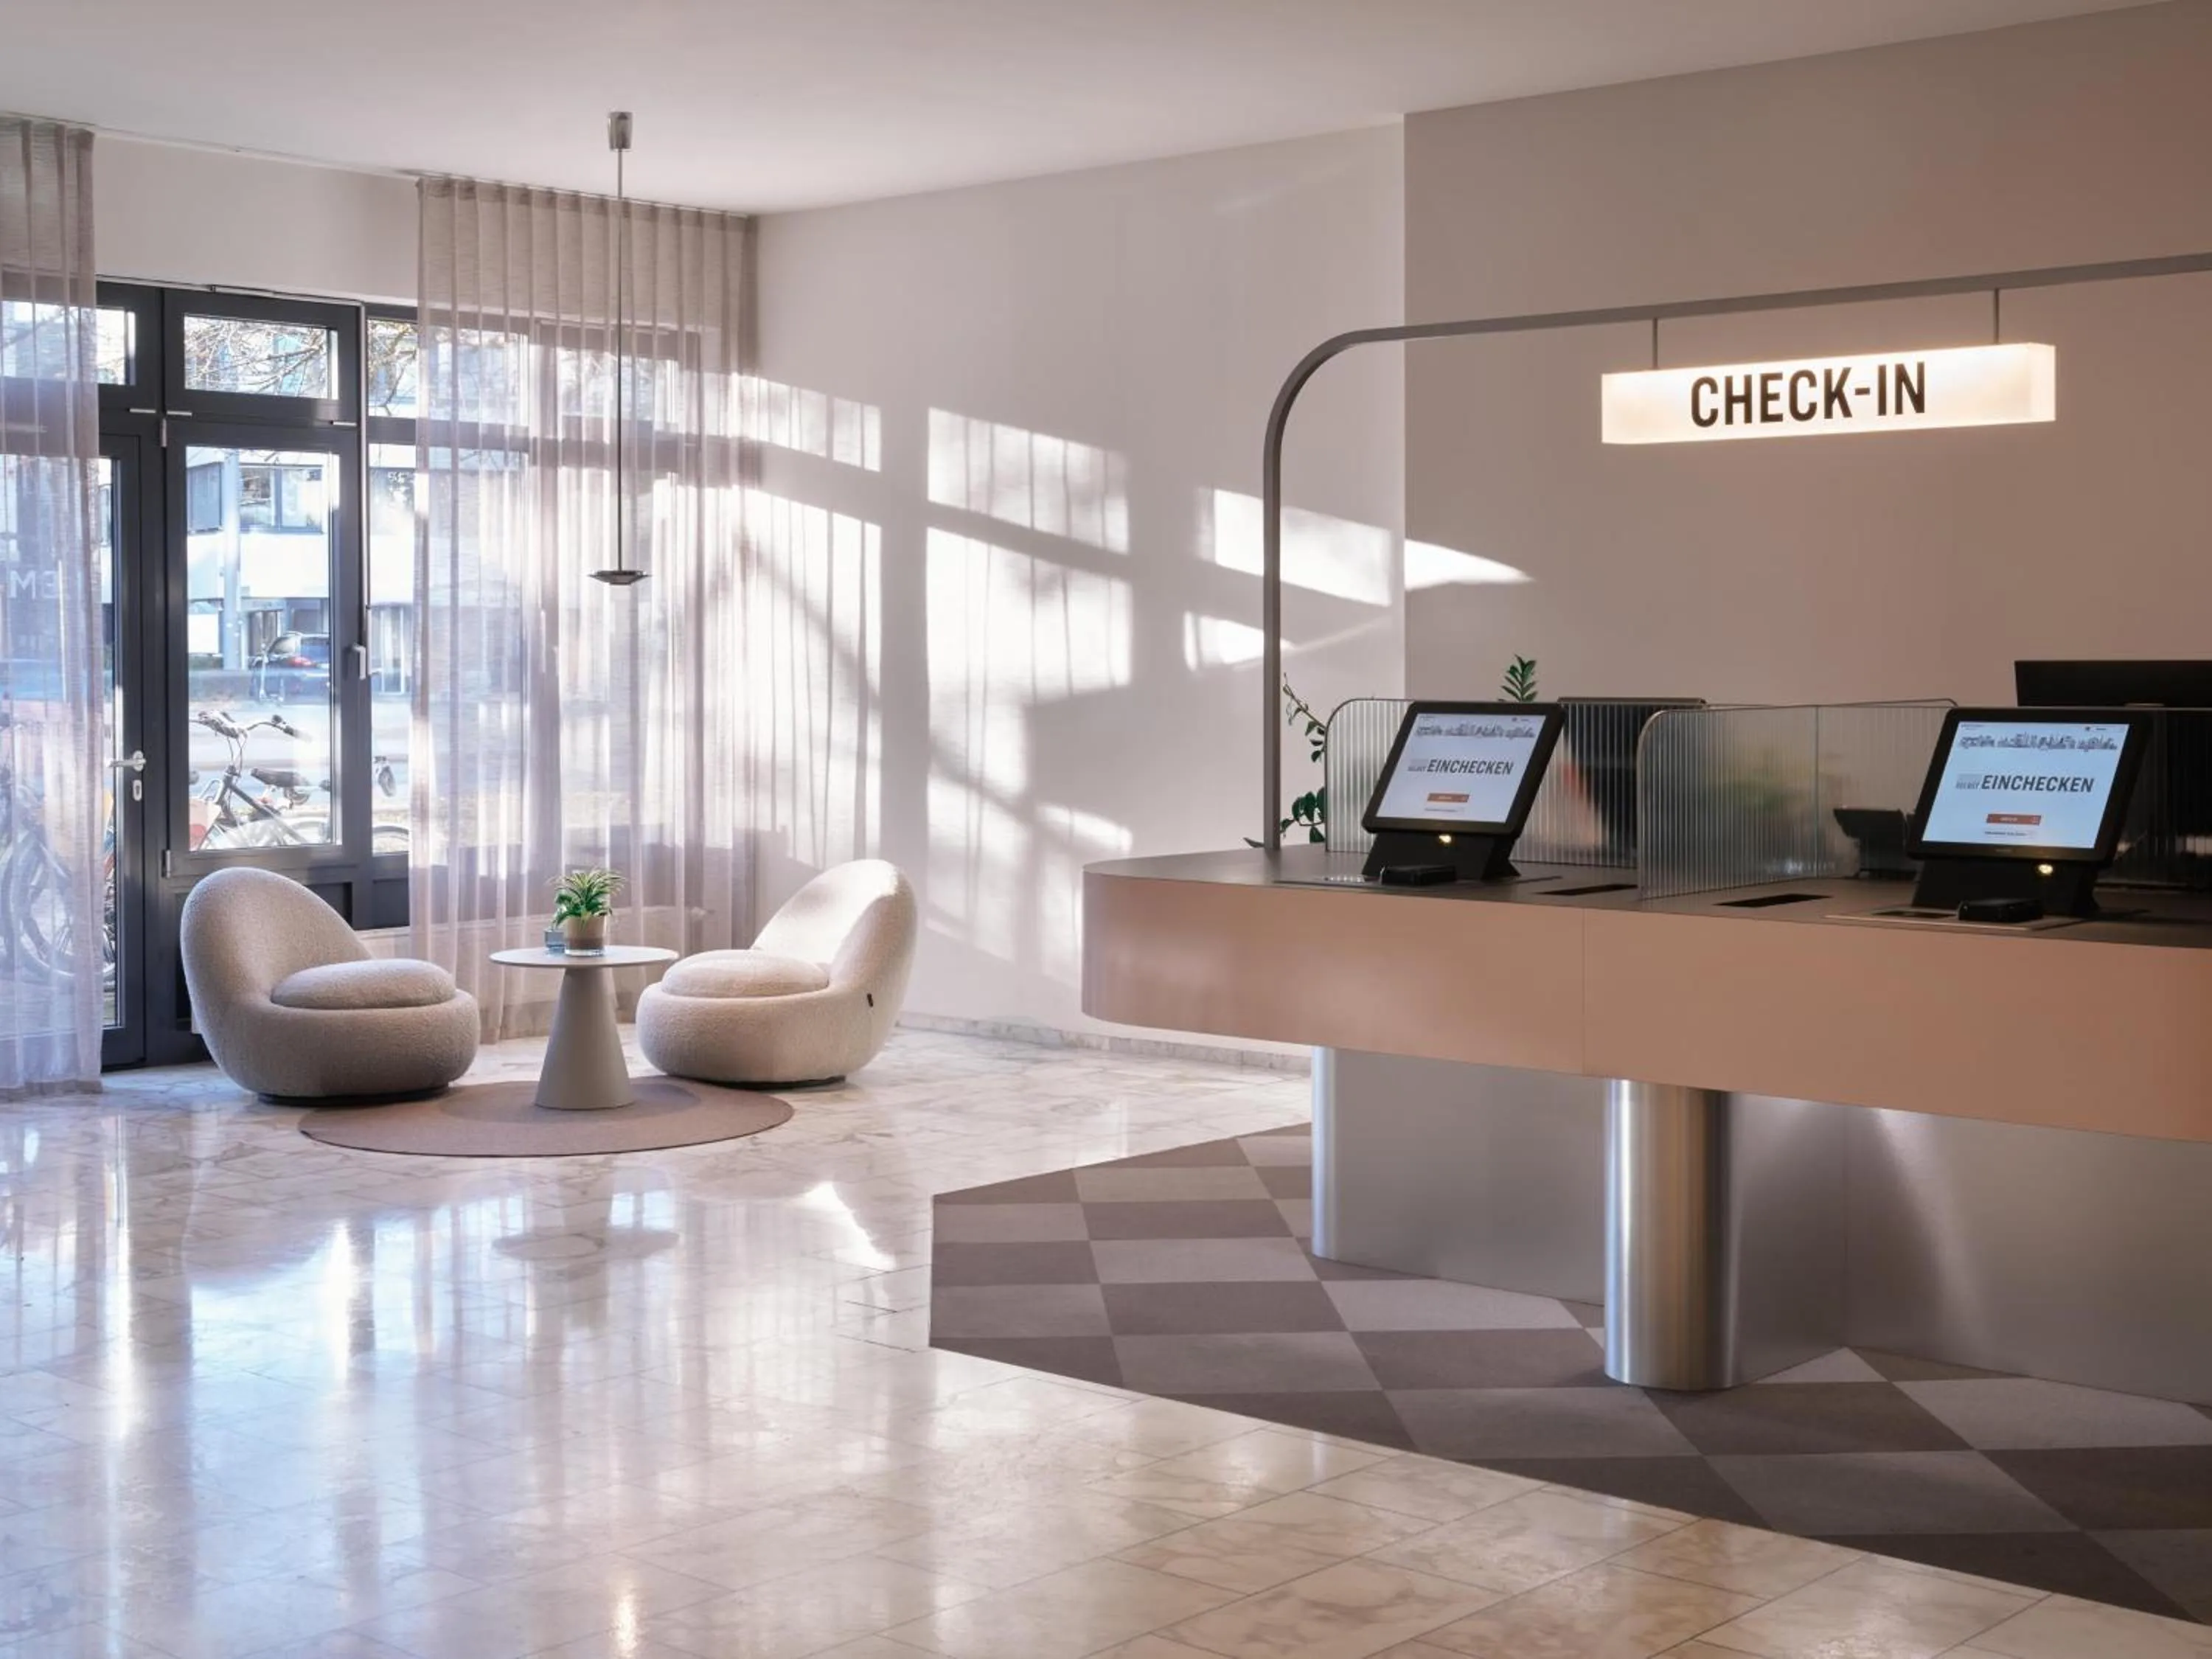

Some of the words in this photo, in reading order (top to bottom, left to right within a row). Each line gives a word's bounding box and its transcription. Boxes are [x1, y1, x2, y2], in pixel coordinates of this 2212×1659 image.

[1691, 361, 1925, 428] CHECK-IN
[1427, 759, 1514, 775] EINCHECKEN
[1981, 774, 2095, 793] EINCHECKEN
